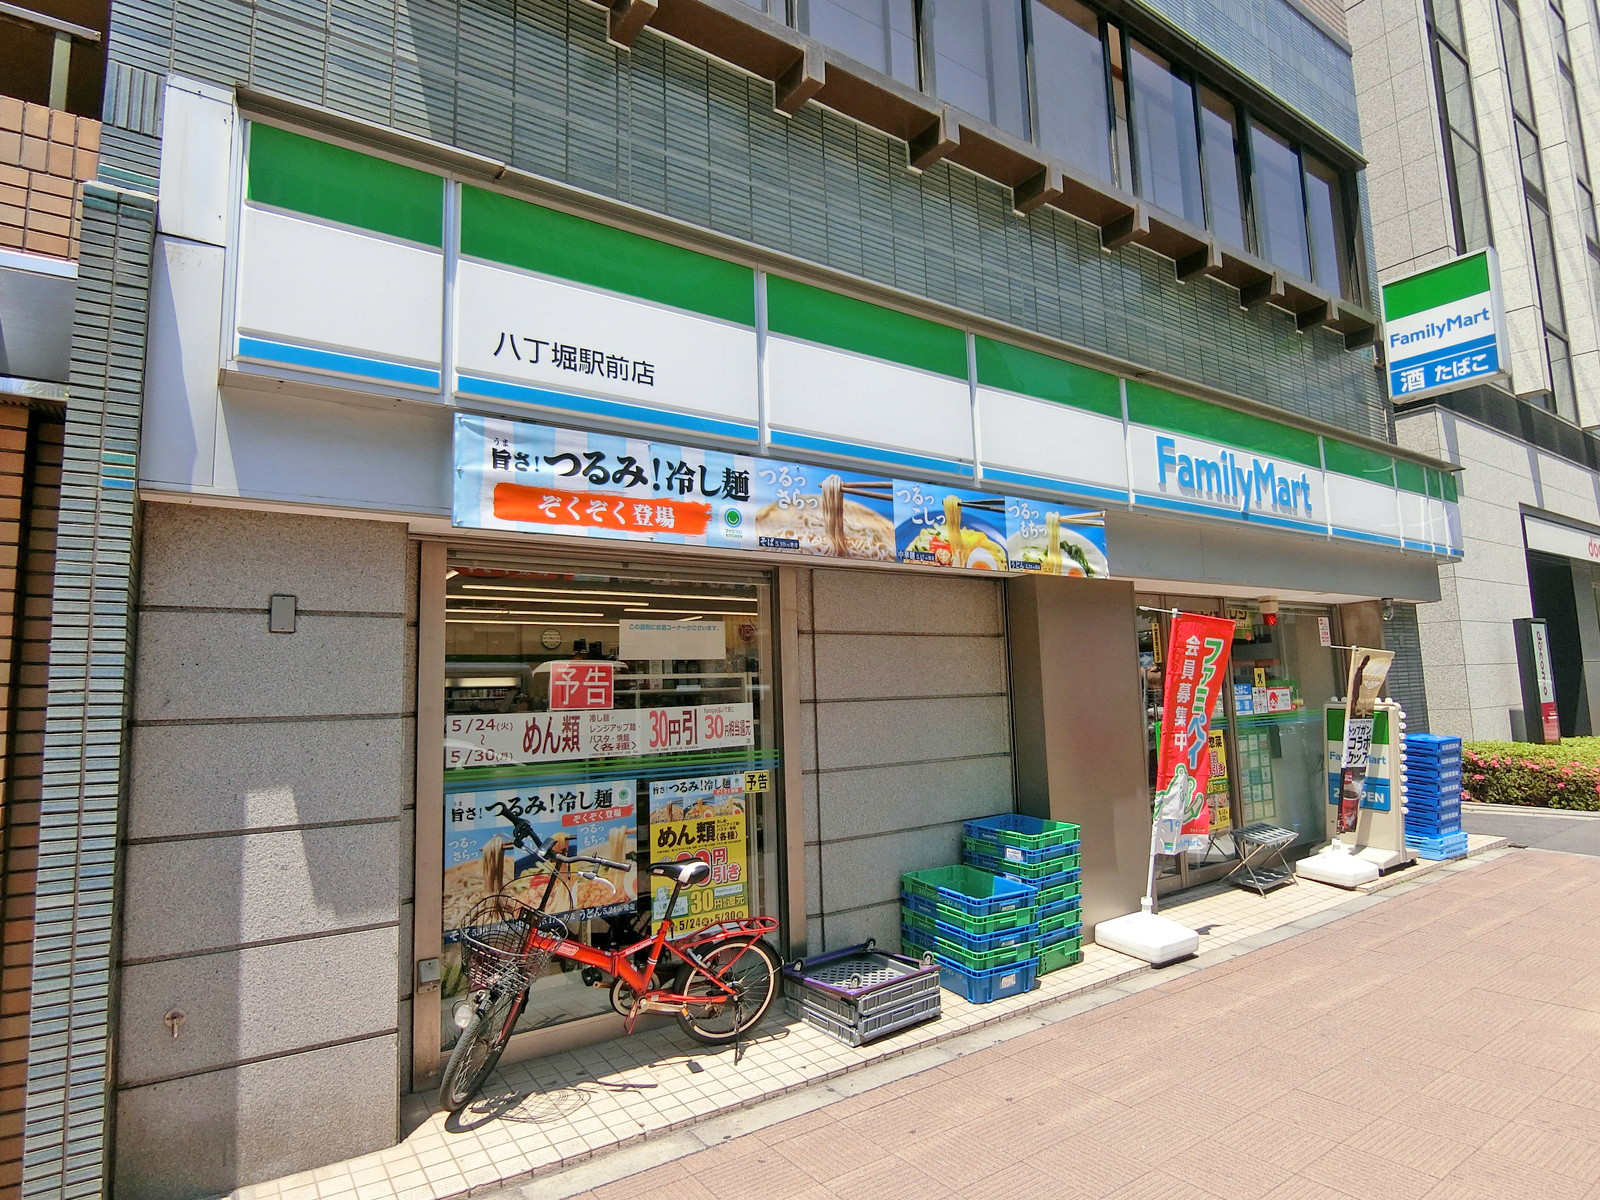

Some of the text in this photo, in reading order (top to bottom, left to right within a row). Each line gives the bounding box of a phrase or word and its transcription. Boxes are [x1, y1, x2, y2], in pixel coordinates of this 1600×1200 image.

[1390, 307, 1490, 348] FamilyMart
[493, 332, 655, 386] 八丁堀駅前店
[1401, 354, 1489, 392] 酒 たばこ
[1155, 434, 1313, 513] FamilyMart
[538, 495, 676, 529] ぞくぞく登場
[555, 666, 610, 705] 予告
[1174, 635, 1201, 752] 会員募集中
[1187, 637, 1224, 770] ファミペイ
[523, 716, 580, 755] めん類
[649, 709, 698, 748] 30円引
[746, 774, 768, 790] 予告
[657, 821, 716, 849] めん類
